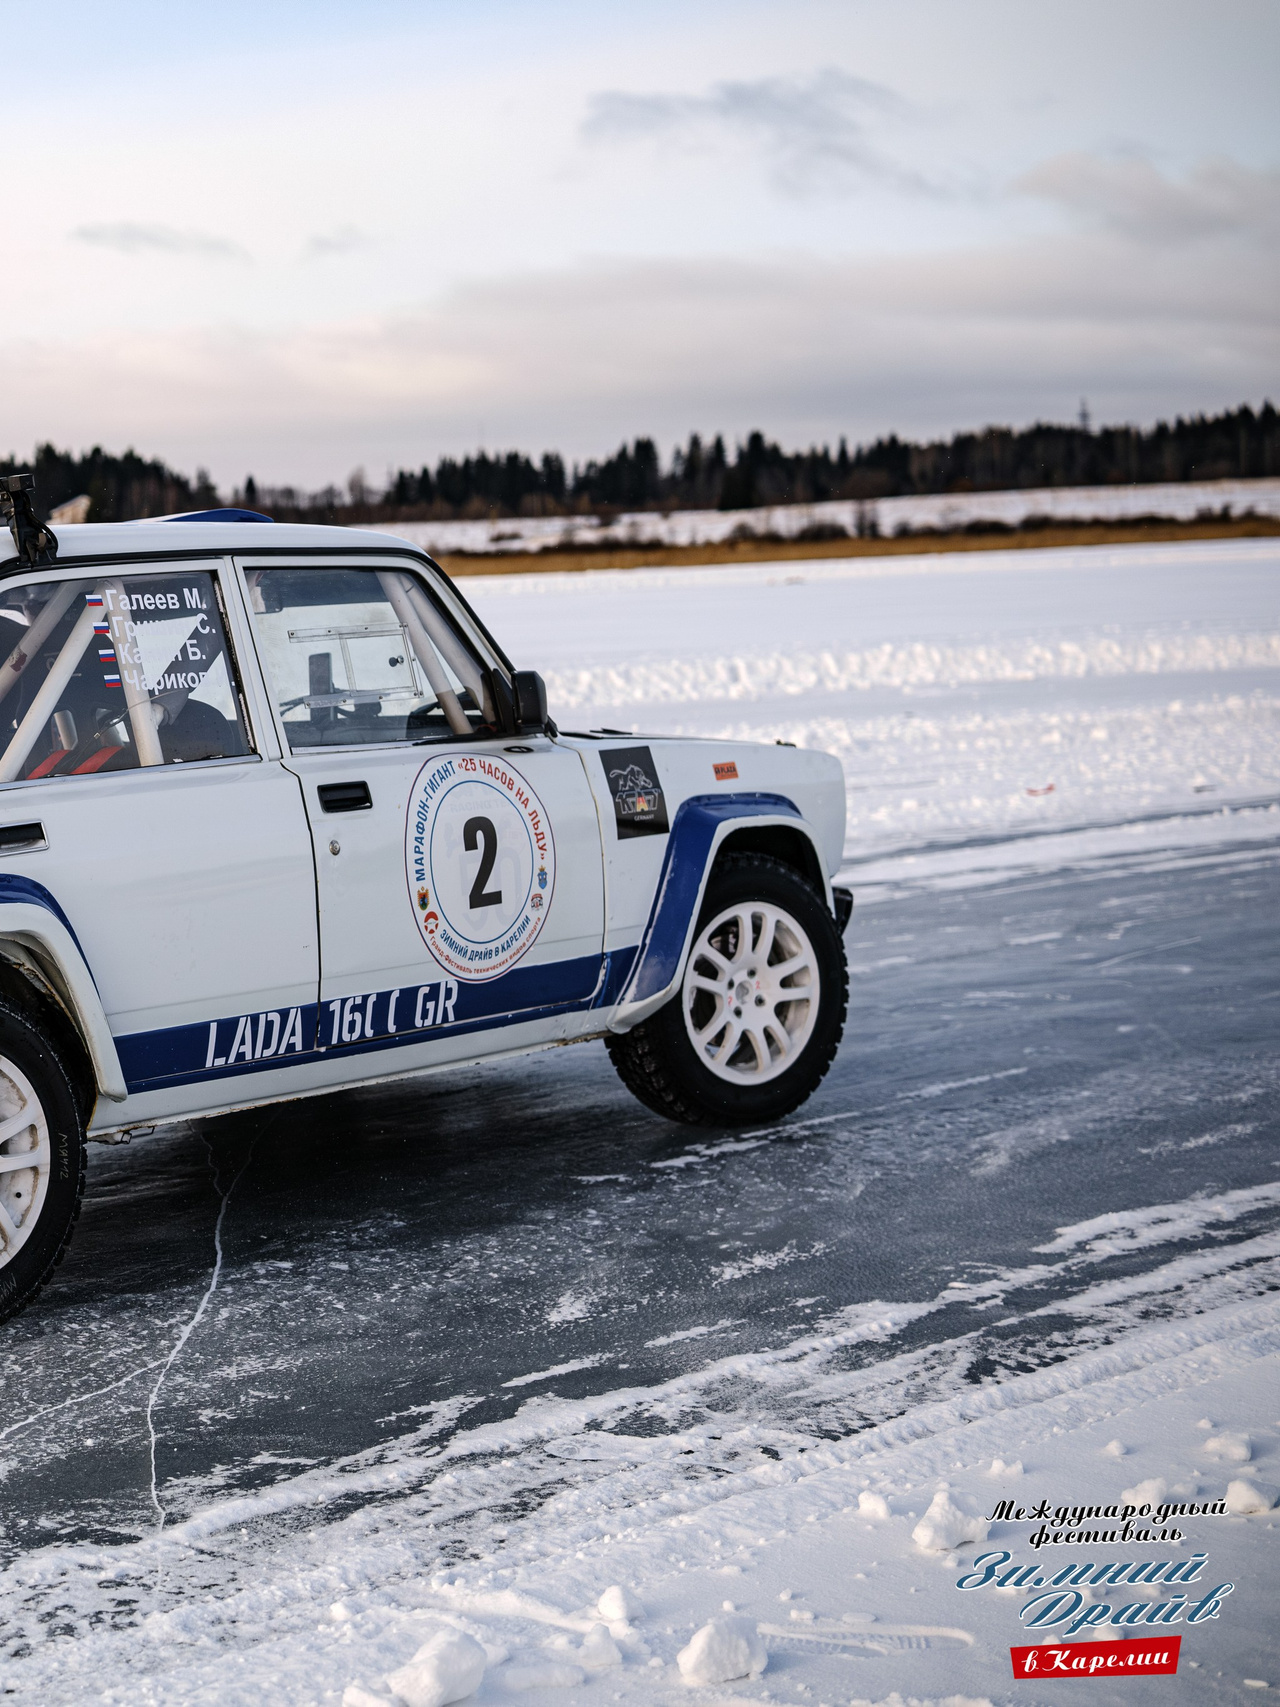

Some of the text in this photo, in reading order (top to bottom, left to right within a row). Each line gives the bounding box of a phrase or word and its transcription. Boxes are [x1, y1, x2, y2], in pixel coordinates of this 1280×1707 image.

[105, 589, 180, 611] Галеев
[414, 761, 456, 881] МАРАФОН-ГИГАНТ
[479, 759, 515, 791] ЧАСОВ
[515, 787, 530, 809] НА
[463, 816, 503, 910] 2
[440, 915, 531, 962] ЗИМНИЙ ДРАЙВ В КАРЕЛИИ
[205, 1007, 303, 1068] LADA
[415, 980, 459, 1028] GR
